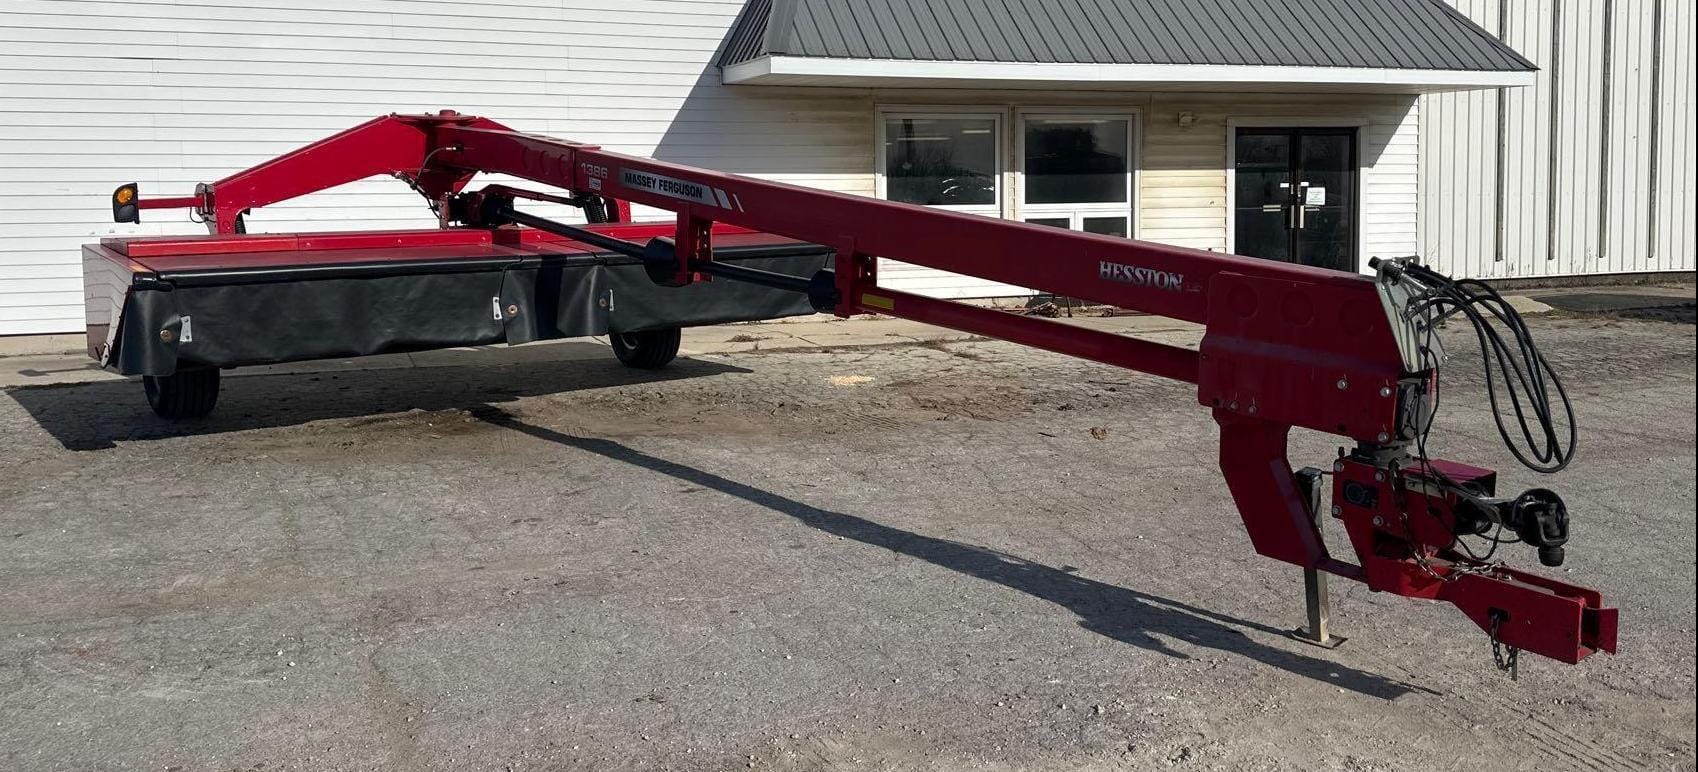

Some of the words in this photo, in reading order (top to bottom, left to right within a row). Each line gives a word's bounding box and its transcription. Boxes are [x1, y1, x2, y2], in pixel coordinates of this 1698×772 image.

[580, 162, 608, 179] 1386
[624, 173, 657, 189] MASSEY
[658, 179, 703, 199] FERGUSON
[1099, 261, 1184, 292] HESSTON
